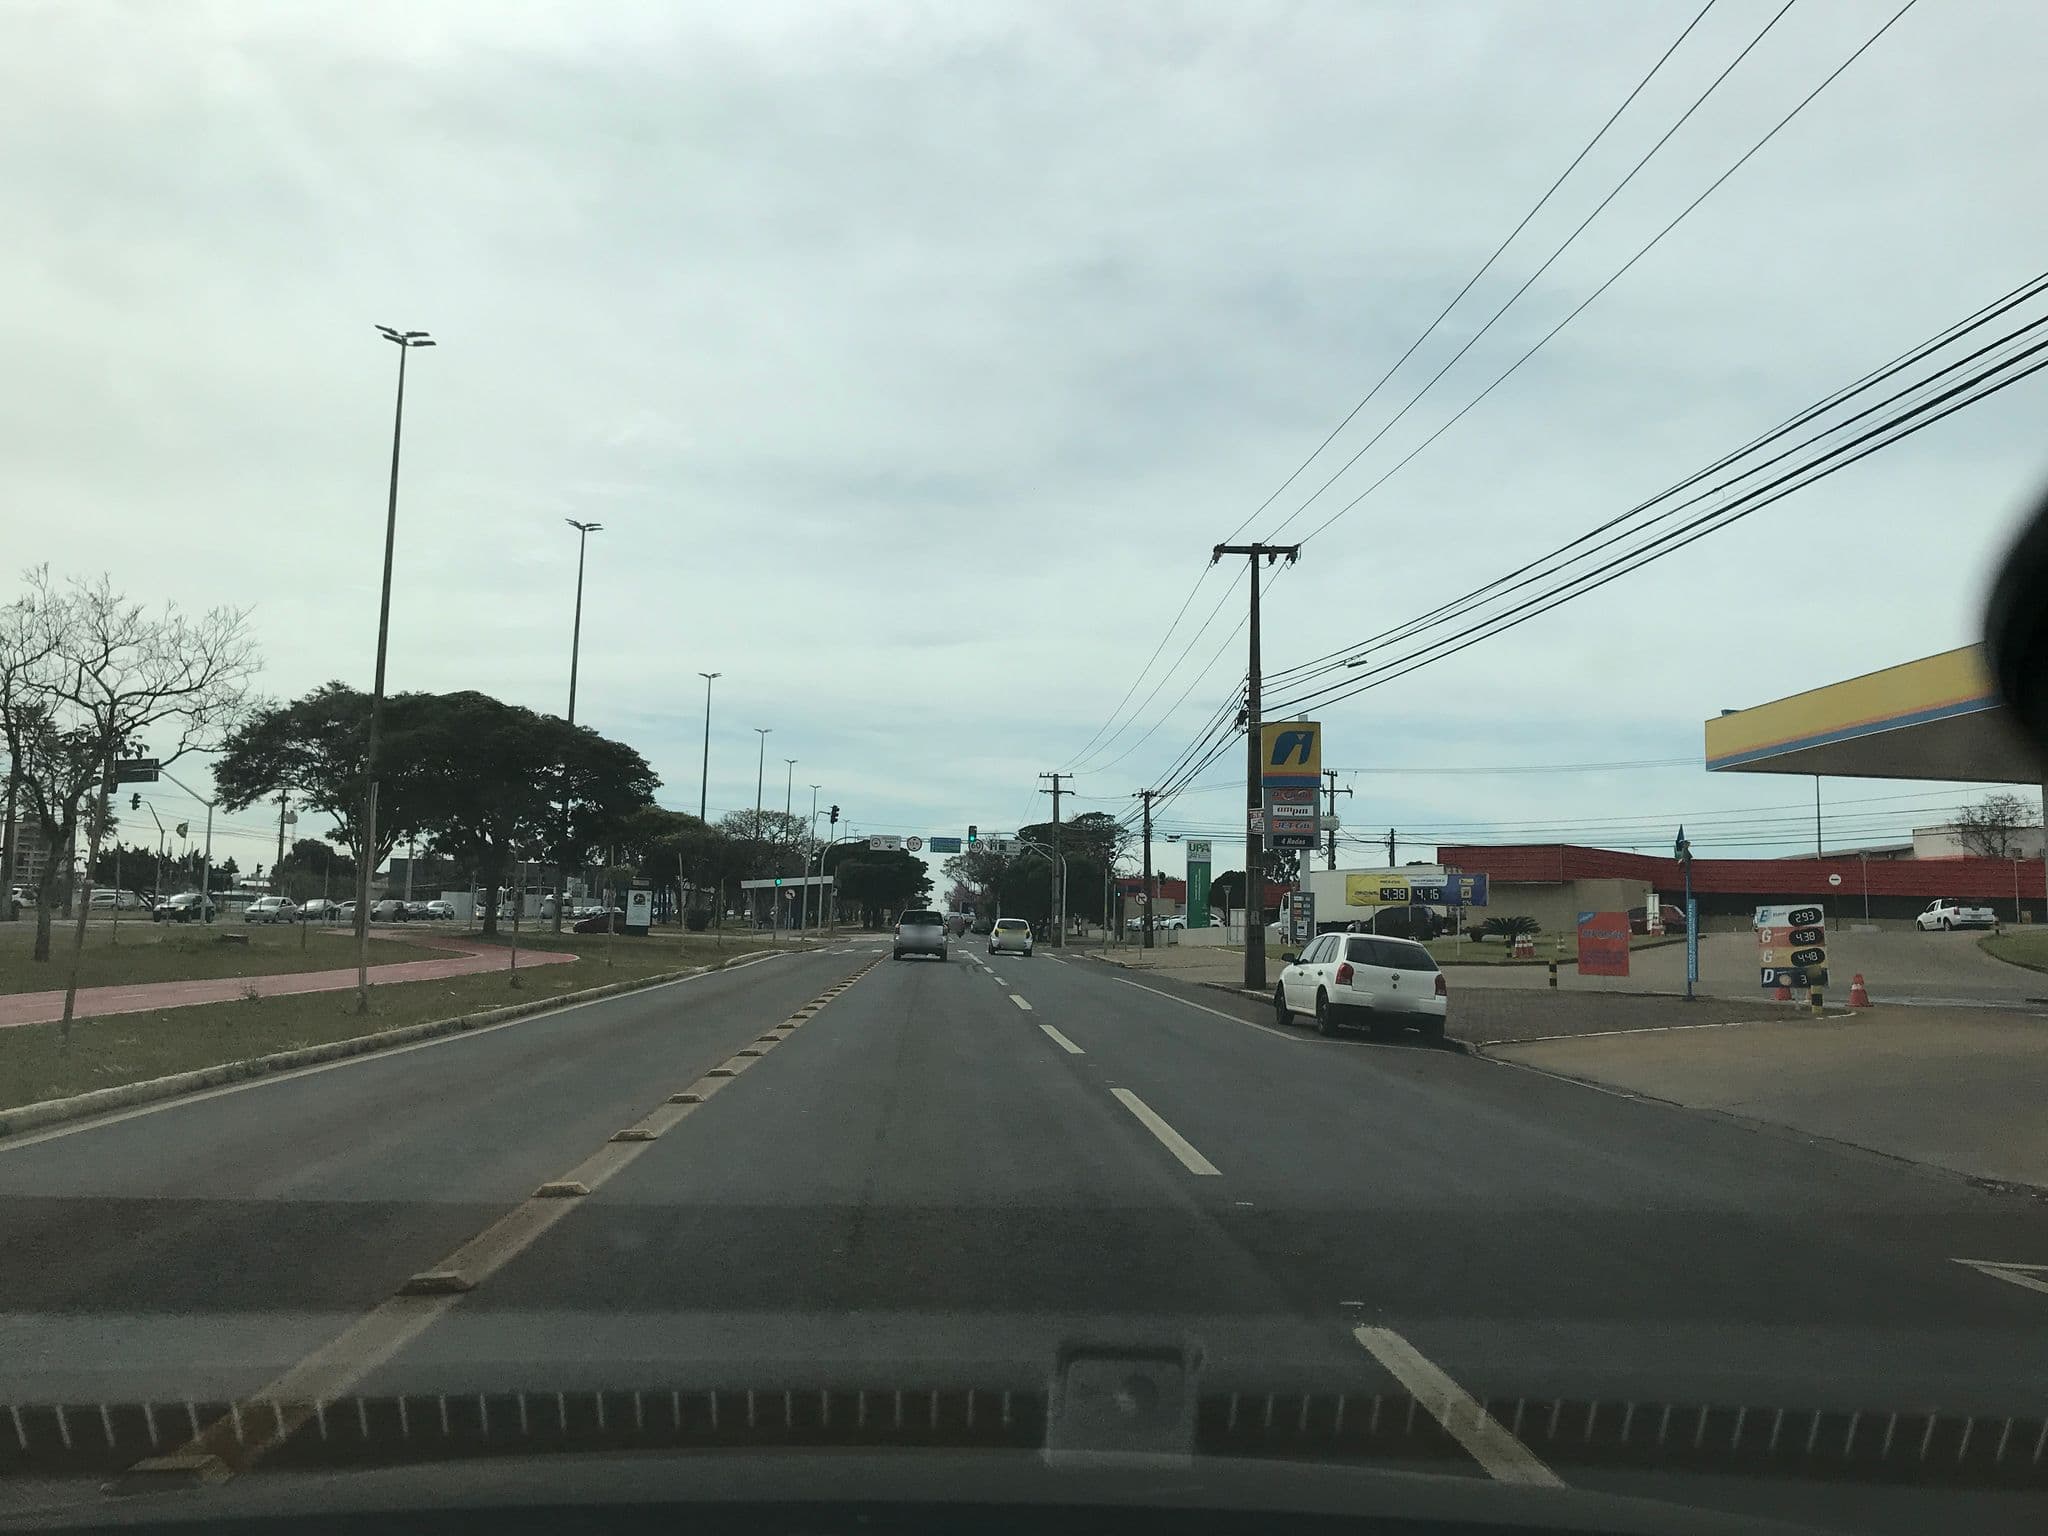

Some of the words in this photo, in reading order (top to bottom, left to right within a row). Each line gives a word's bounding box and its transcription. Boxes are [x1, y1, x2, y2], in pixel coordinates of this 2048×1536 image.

[1189, 843, 1210, 853] UPA
[1760, 910, 1769, 922] E
[1795, 911, 1815, 923] 293
[1761, 929, 1772, 943] G
[1795, 931, 1816, 942] 438
[1763, 950, 1773, 963] G
[1797, 951, 1818, 962] 448
[1763, 969, 1775, 983] D
